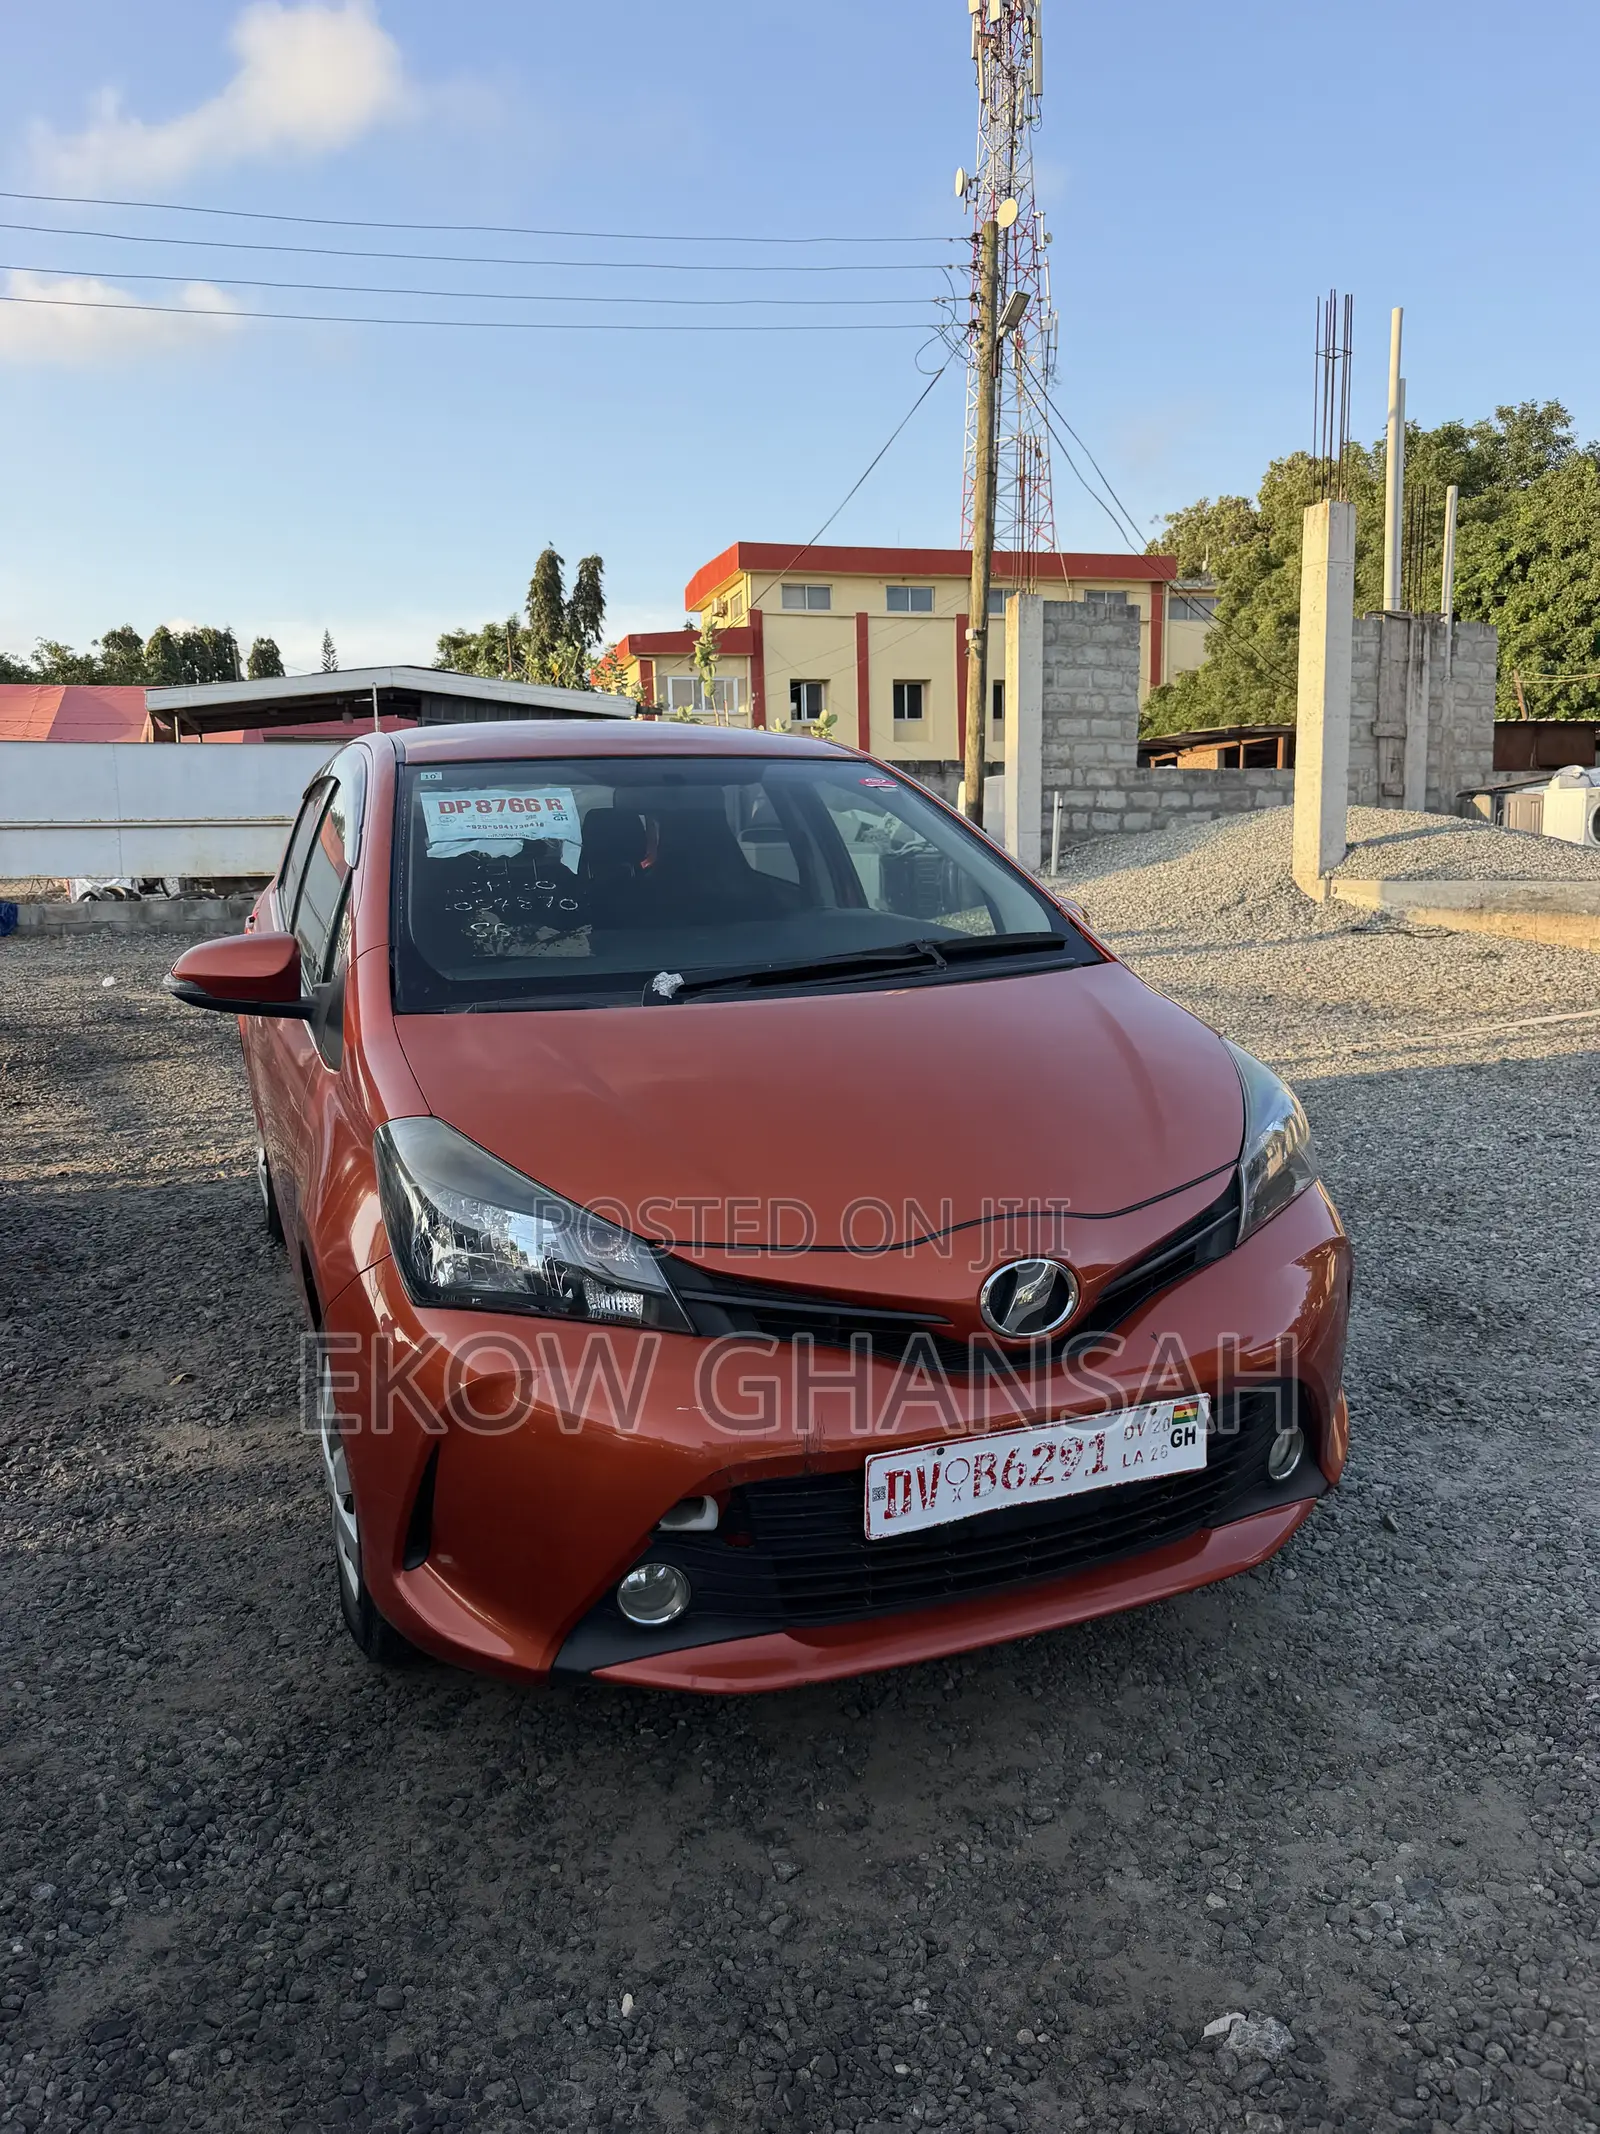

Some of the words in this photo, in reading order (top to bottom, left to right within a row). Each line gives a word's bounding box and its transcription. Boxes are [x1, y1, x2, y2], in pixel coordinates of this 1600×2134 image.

[438, 800, 472, 814] DP
[474, 797, 542, 813] 8766
[545, 798, 564, 811] R
[1170, 1425, 1197, 1448] GH
[1122, 1450, 1144, 1468] LA
[883, 1461, 942, 1520] DV
[972, 1430, 1109, 1498] B6291
